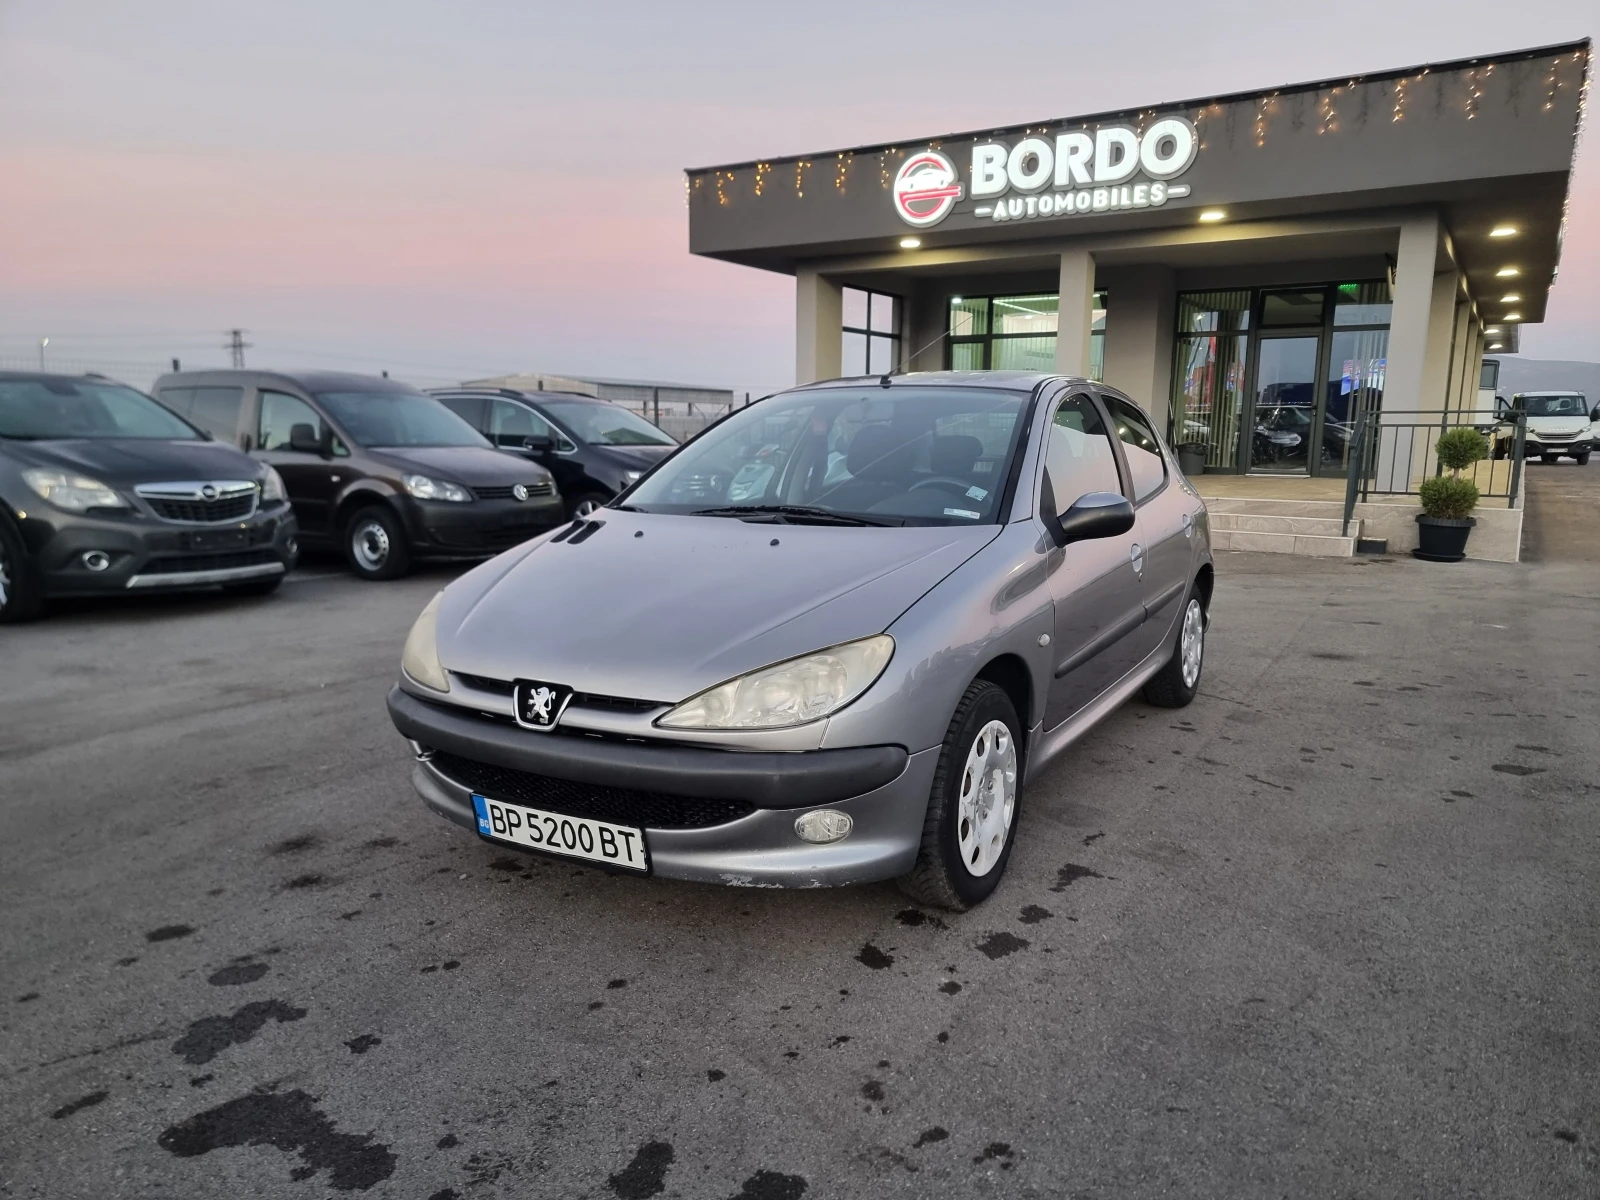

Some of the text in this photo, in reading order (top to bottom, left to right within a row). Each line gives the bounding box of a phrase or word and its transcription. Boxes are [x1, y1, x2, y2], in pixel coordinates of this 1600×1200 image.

[970, 119, 1194, 196] BORDO
[479, 818, 490, 829] BG
[490, 804, 636, 862] BP 5200 BT
